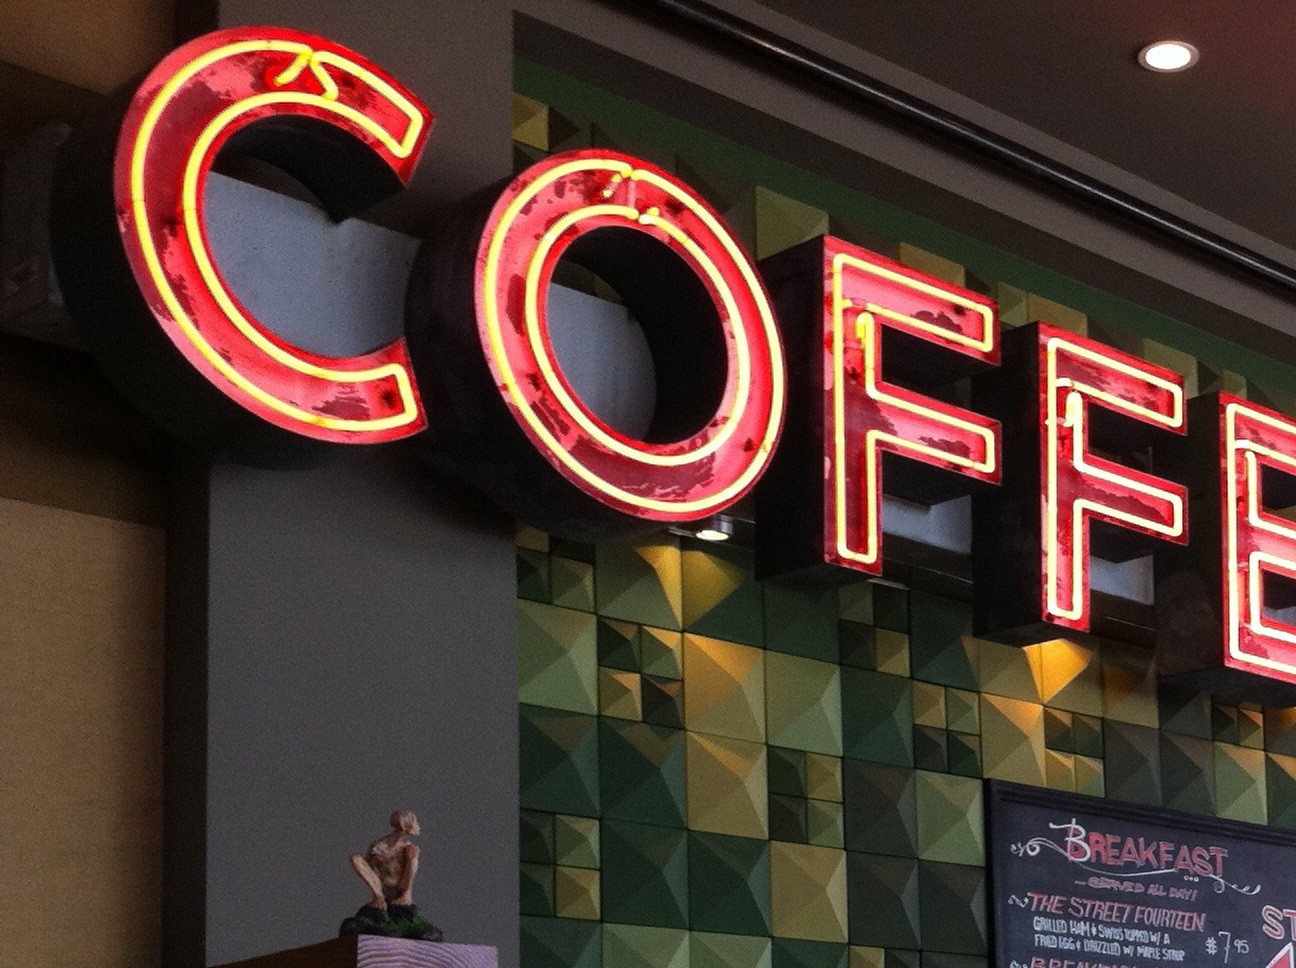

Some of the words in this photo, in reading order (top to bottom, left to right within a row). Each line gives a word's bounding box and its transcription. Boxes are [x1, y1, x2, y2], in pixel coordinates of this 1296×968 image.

[1049, 818, 1228, 877] BREAKFAST
[1147, 884, 1167, 896] ALL
[1027, 892, 1067, 914] THE
[1068, 896, 1135, 923] STREET
[1134, 906, 1207, 932] FOURTEEN
[1033, 916, 1067, 934] GRILLED
[1069, 921, 1090, 936] HAM
[1058, 937, 1075, 950] EGG
